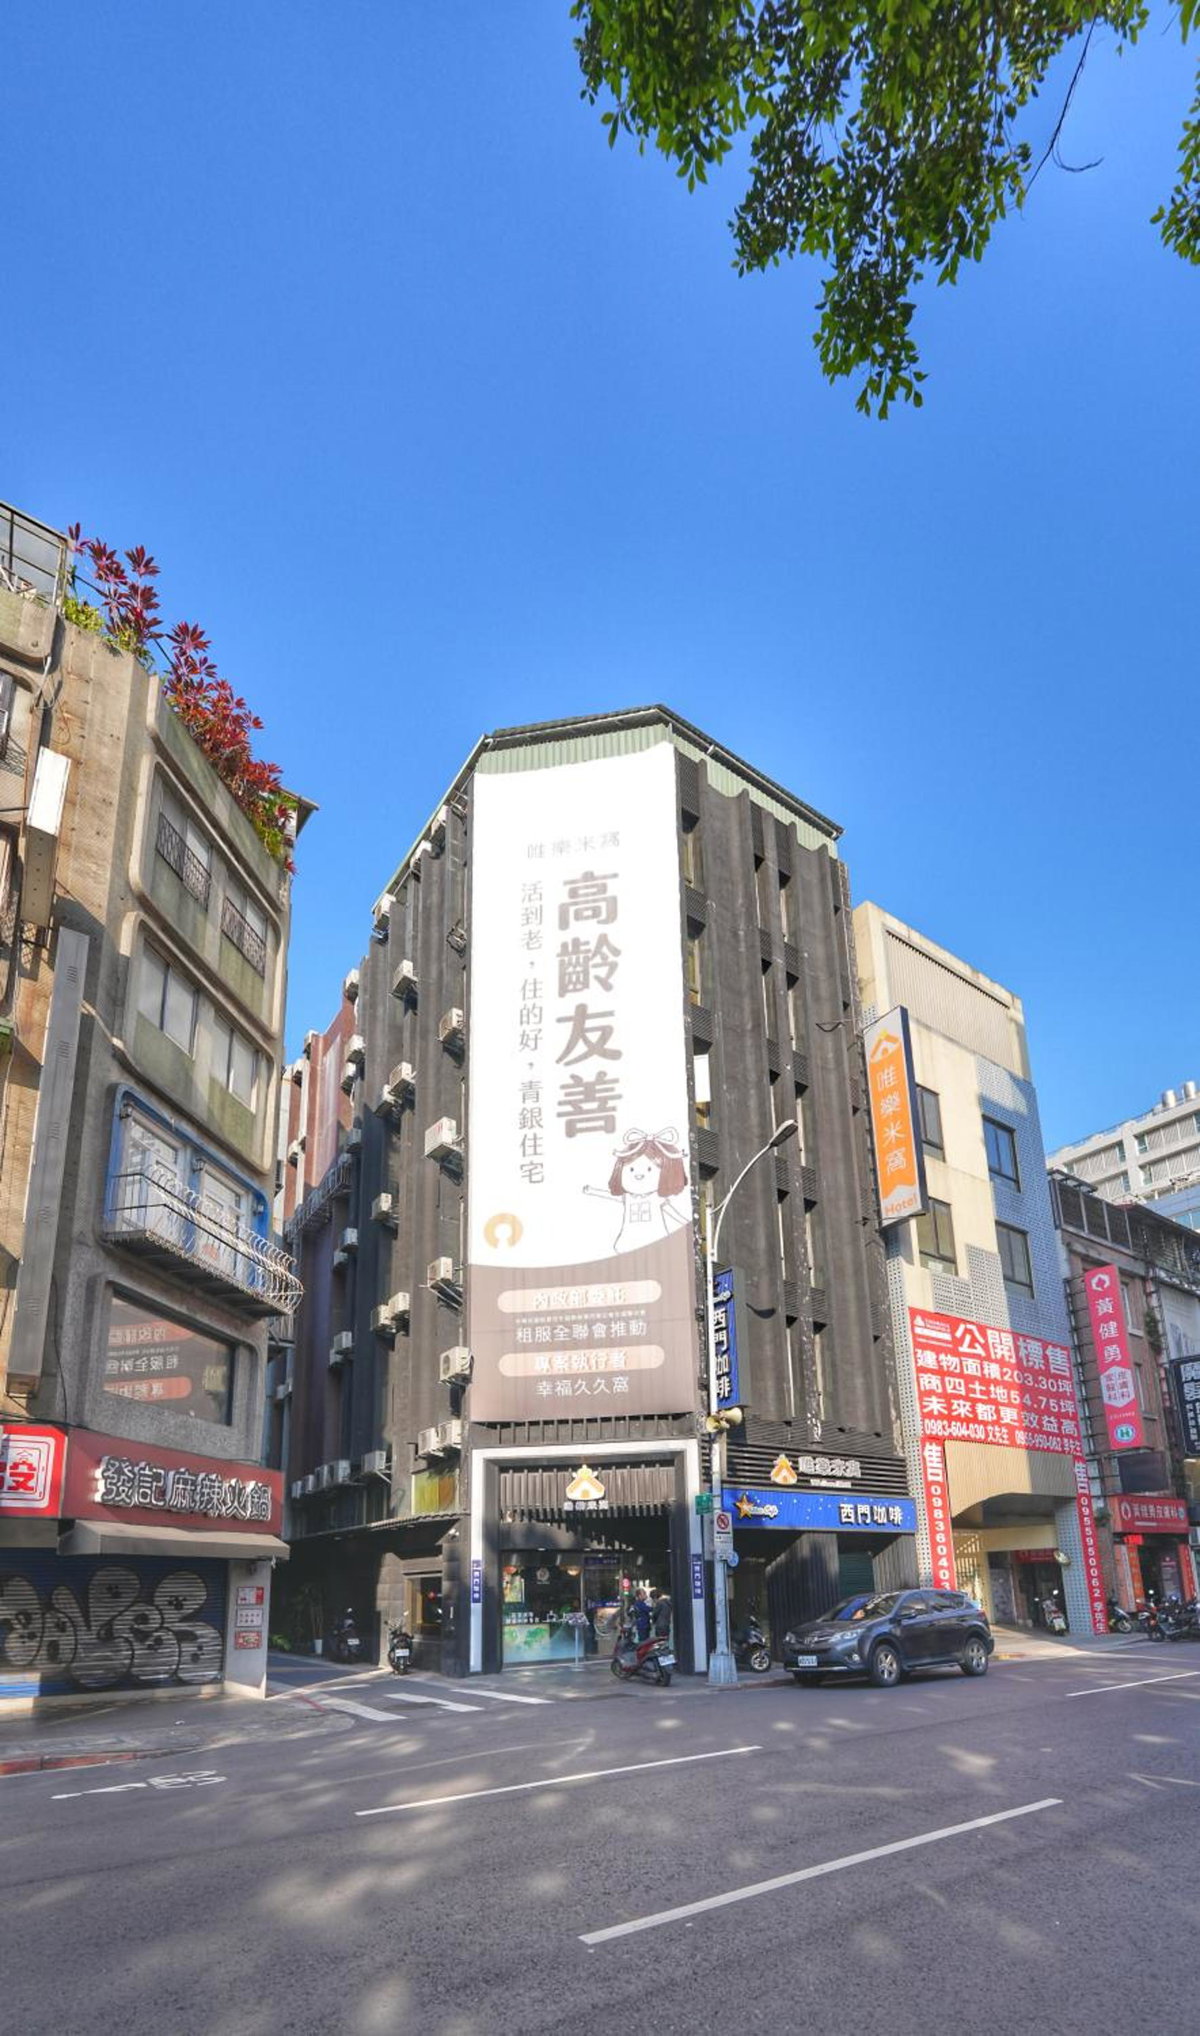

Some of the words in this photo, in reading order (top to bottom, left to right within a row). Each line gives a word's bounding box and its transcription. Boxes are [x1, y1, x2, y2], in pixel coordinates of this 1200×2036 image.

[555, 870, 623, 1139] 高齡友善
[876, 1064, 907, 1176] 唯樂米窩
[885, 1194, 918, 1217] Hotel
[516, 1321, 648, 1345] 租服全聯會推動
[955, 1323, 1071, 1378] 公開標售
[1095, 1297, 1122, 1364] 黃健勇
[915, 1348, 1073, 1396] 建物面積203.30坪
[918, 1373, 1077, 1417] 商四土地54.75坪
[922, 1396, 1079, 1438] 未來都更效益高
[924, 1419, 985, 1440] 0983-604-030
[924, 1441, 944, 1482] 售
[101, 1456, 272, 1521] 發記麻辣火鍋
[839, 1503, 904, 1526] 西門咖啡
